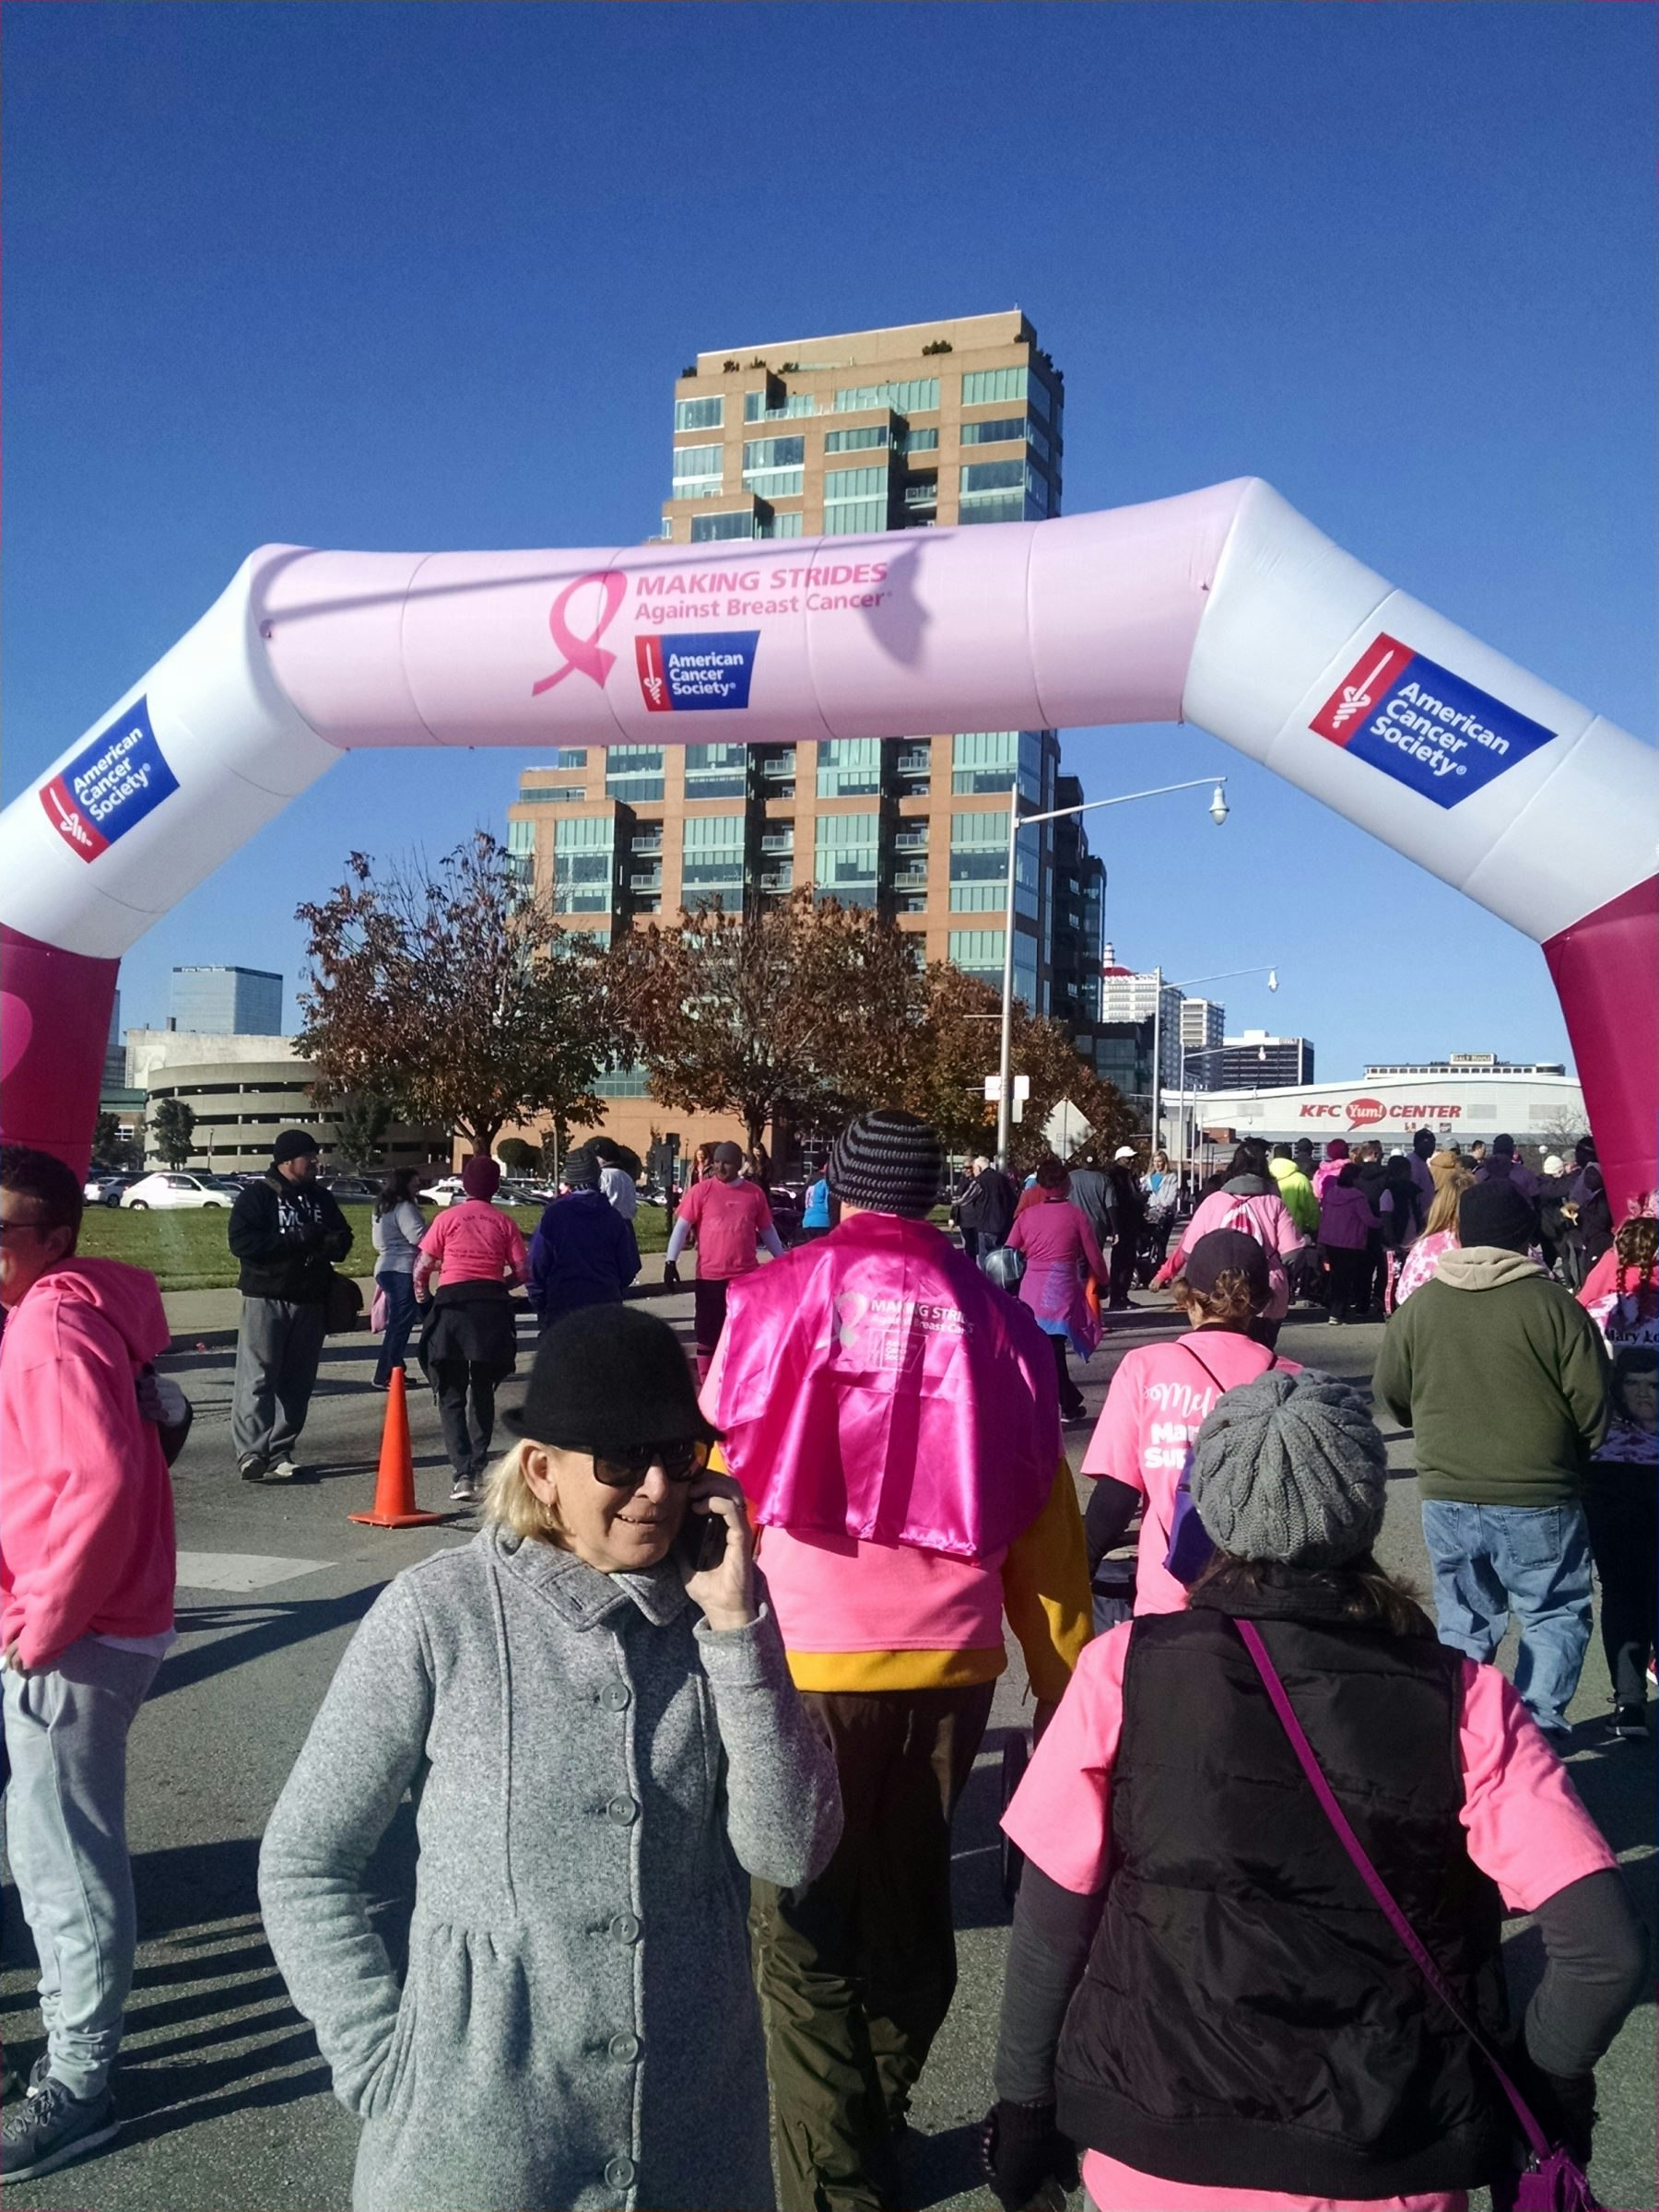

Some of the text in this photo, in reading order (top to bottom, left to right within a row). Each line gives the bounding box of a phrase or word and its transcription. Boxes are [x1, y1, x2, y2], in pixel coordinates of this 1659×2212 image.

[635, 562, 888, 596] MAKING STRIDES
[634, 599, 721, 625] Against
[726, 595, 800, 617] Breast
[668, 651, 744, 668] American
[669, 667, 724, 682] Cancer
[1385, 698, 1467, 754] Cancer
[1397, 681, 1510, 756] American
[73, 726, 144, 794] American
[79, 757, 133, 806] Cancer
[1299, 1103, 1463, 1119] KFC Yum! CENTER
